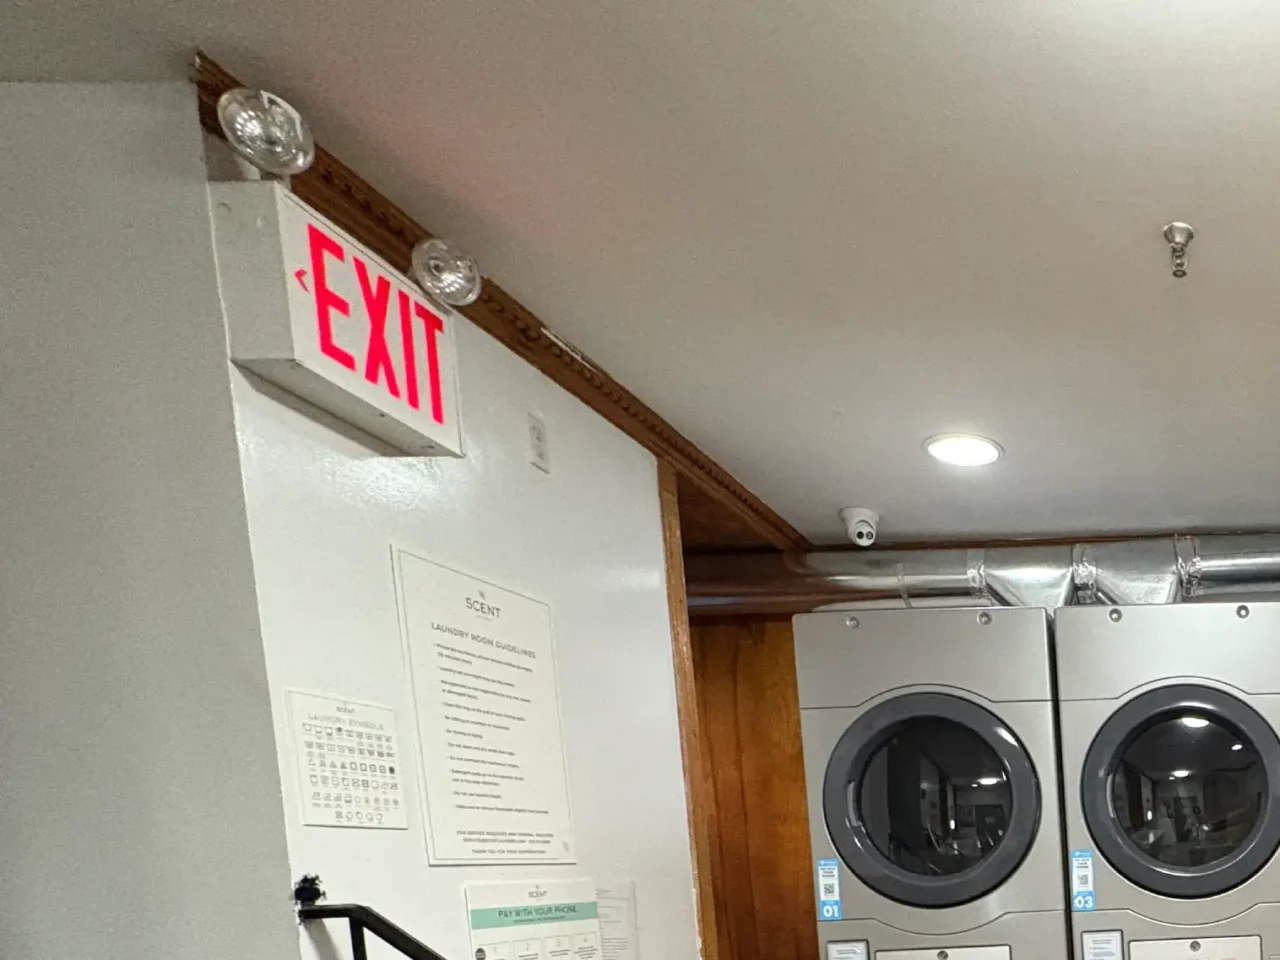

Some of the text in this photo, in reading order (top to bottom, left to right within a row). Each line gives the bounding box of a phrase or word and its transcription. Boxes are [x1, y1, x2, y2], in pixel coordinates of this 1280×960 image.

[307, 222, 445, 425] EXIT
[465, 597, 501, 618] SCENT
[431, 622, 469, 639] LAUNDRY
[471, 633, 494, 646] ROOM
[495, 640, 536, 659] GUIDELINES
[1075, 895, 1094, 908] 03
[498, 905, 577, 918] PAY WITH YOUR PHONE
[823, 905, 839, 917] 01
